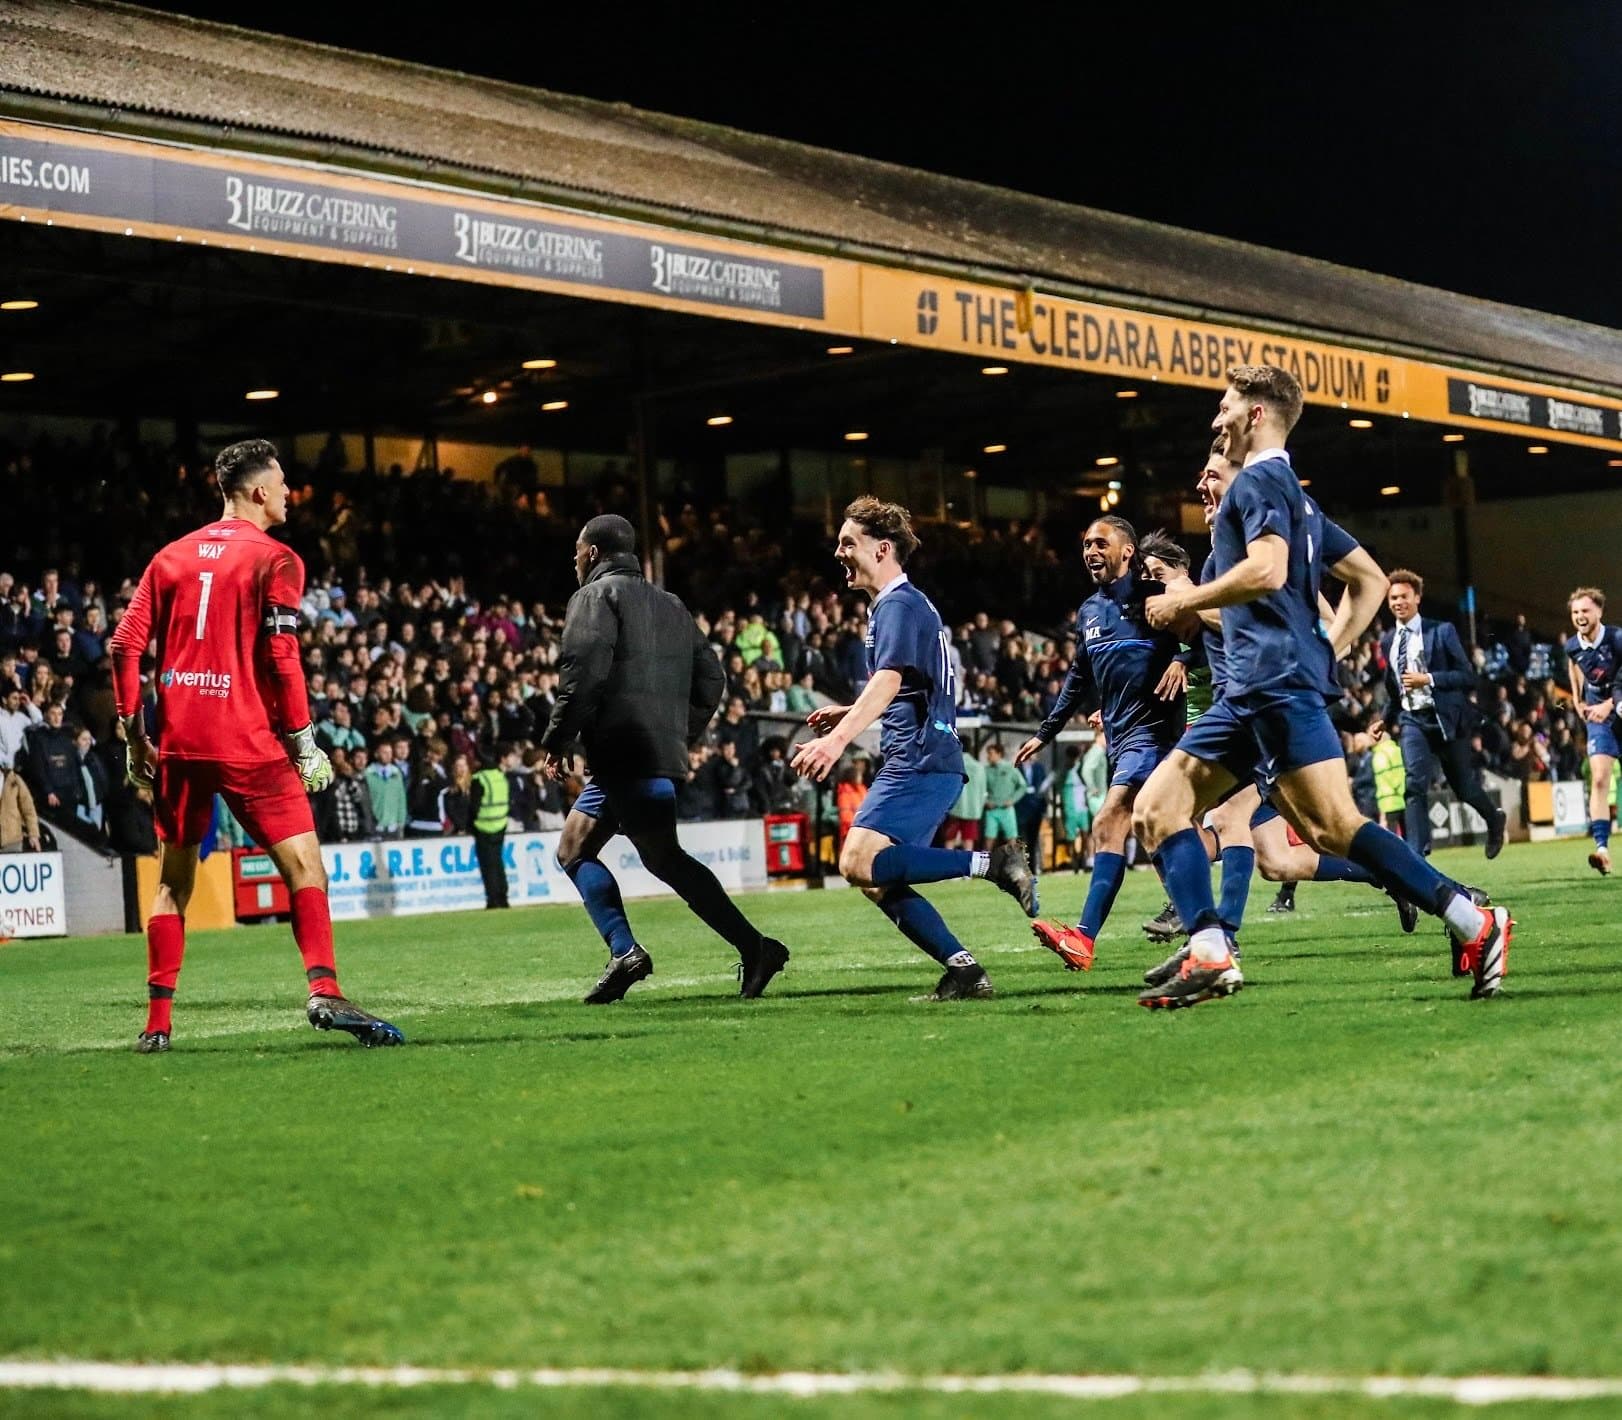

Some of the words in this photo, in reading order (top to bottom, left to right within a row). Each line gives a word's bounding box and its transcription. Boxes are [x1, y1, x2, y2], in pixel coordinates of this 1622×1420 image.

[0, 155, 90, 194] IES.COM
[254, 185, 305, 217] BUZZ
[306, 194, 398, 232] CATERING
[253, 215, 325, 238] EQUIPMENT
[343, 228, 398, 250] SUPPLIES
[479, 221, 523, 250] BUZZ
[523, 229, 603, 262] CATERING
[672, 253, 711, 281] BUZZ
[711, 260, 780, 291] CATERING
[955, 291, 1017, 350] THE
[1029, 304, 1163, 371] CLEDARA
[1169, 329, 1253, 379] ABBEY
[1261, 343, 1367, 402] STADIUM
[198, 543, 227, 559] WAY
[195, 572, 214, 640] 1
[1085, 626, 1101, 641] MA
[175, 669, 231, 689] ventus
[199, 688, 230, 698] energy
[0, 864, 52, 894] OUP
[359, 850, 377, 880] &
[387, 847, 433, 877] R.E.
[440, 842, 517, 874] CLAK
